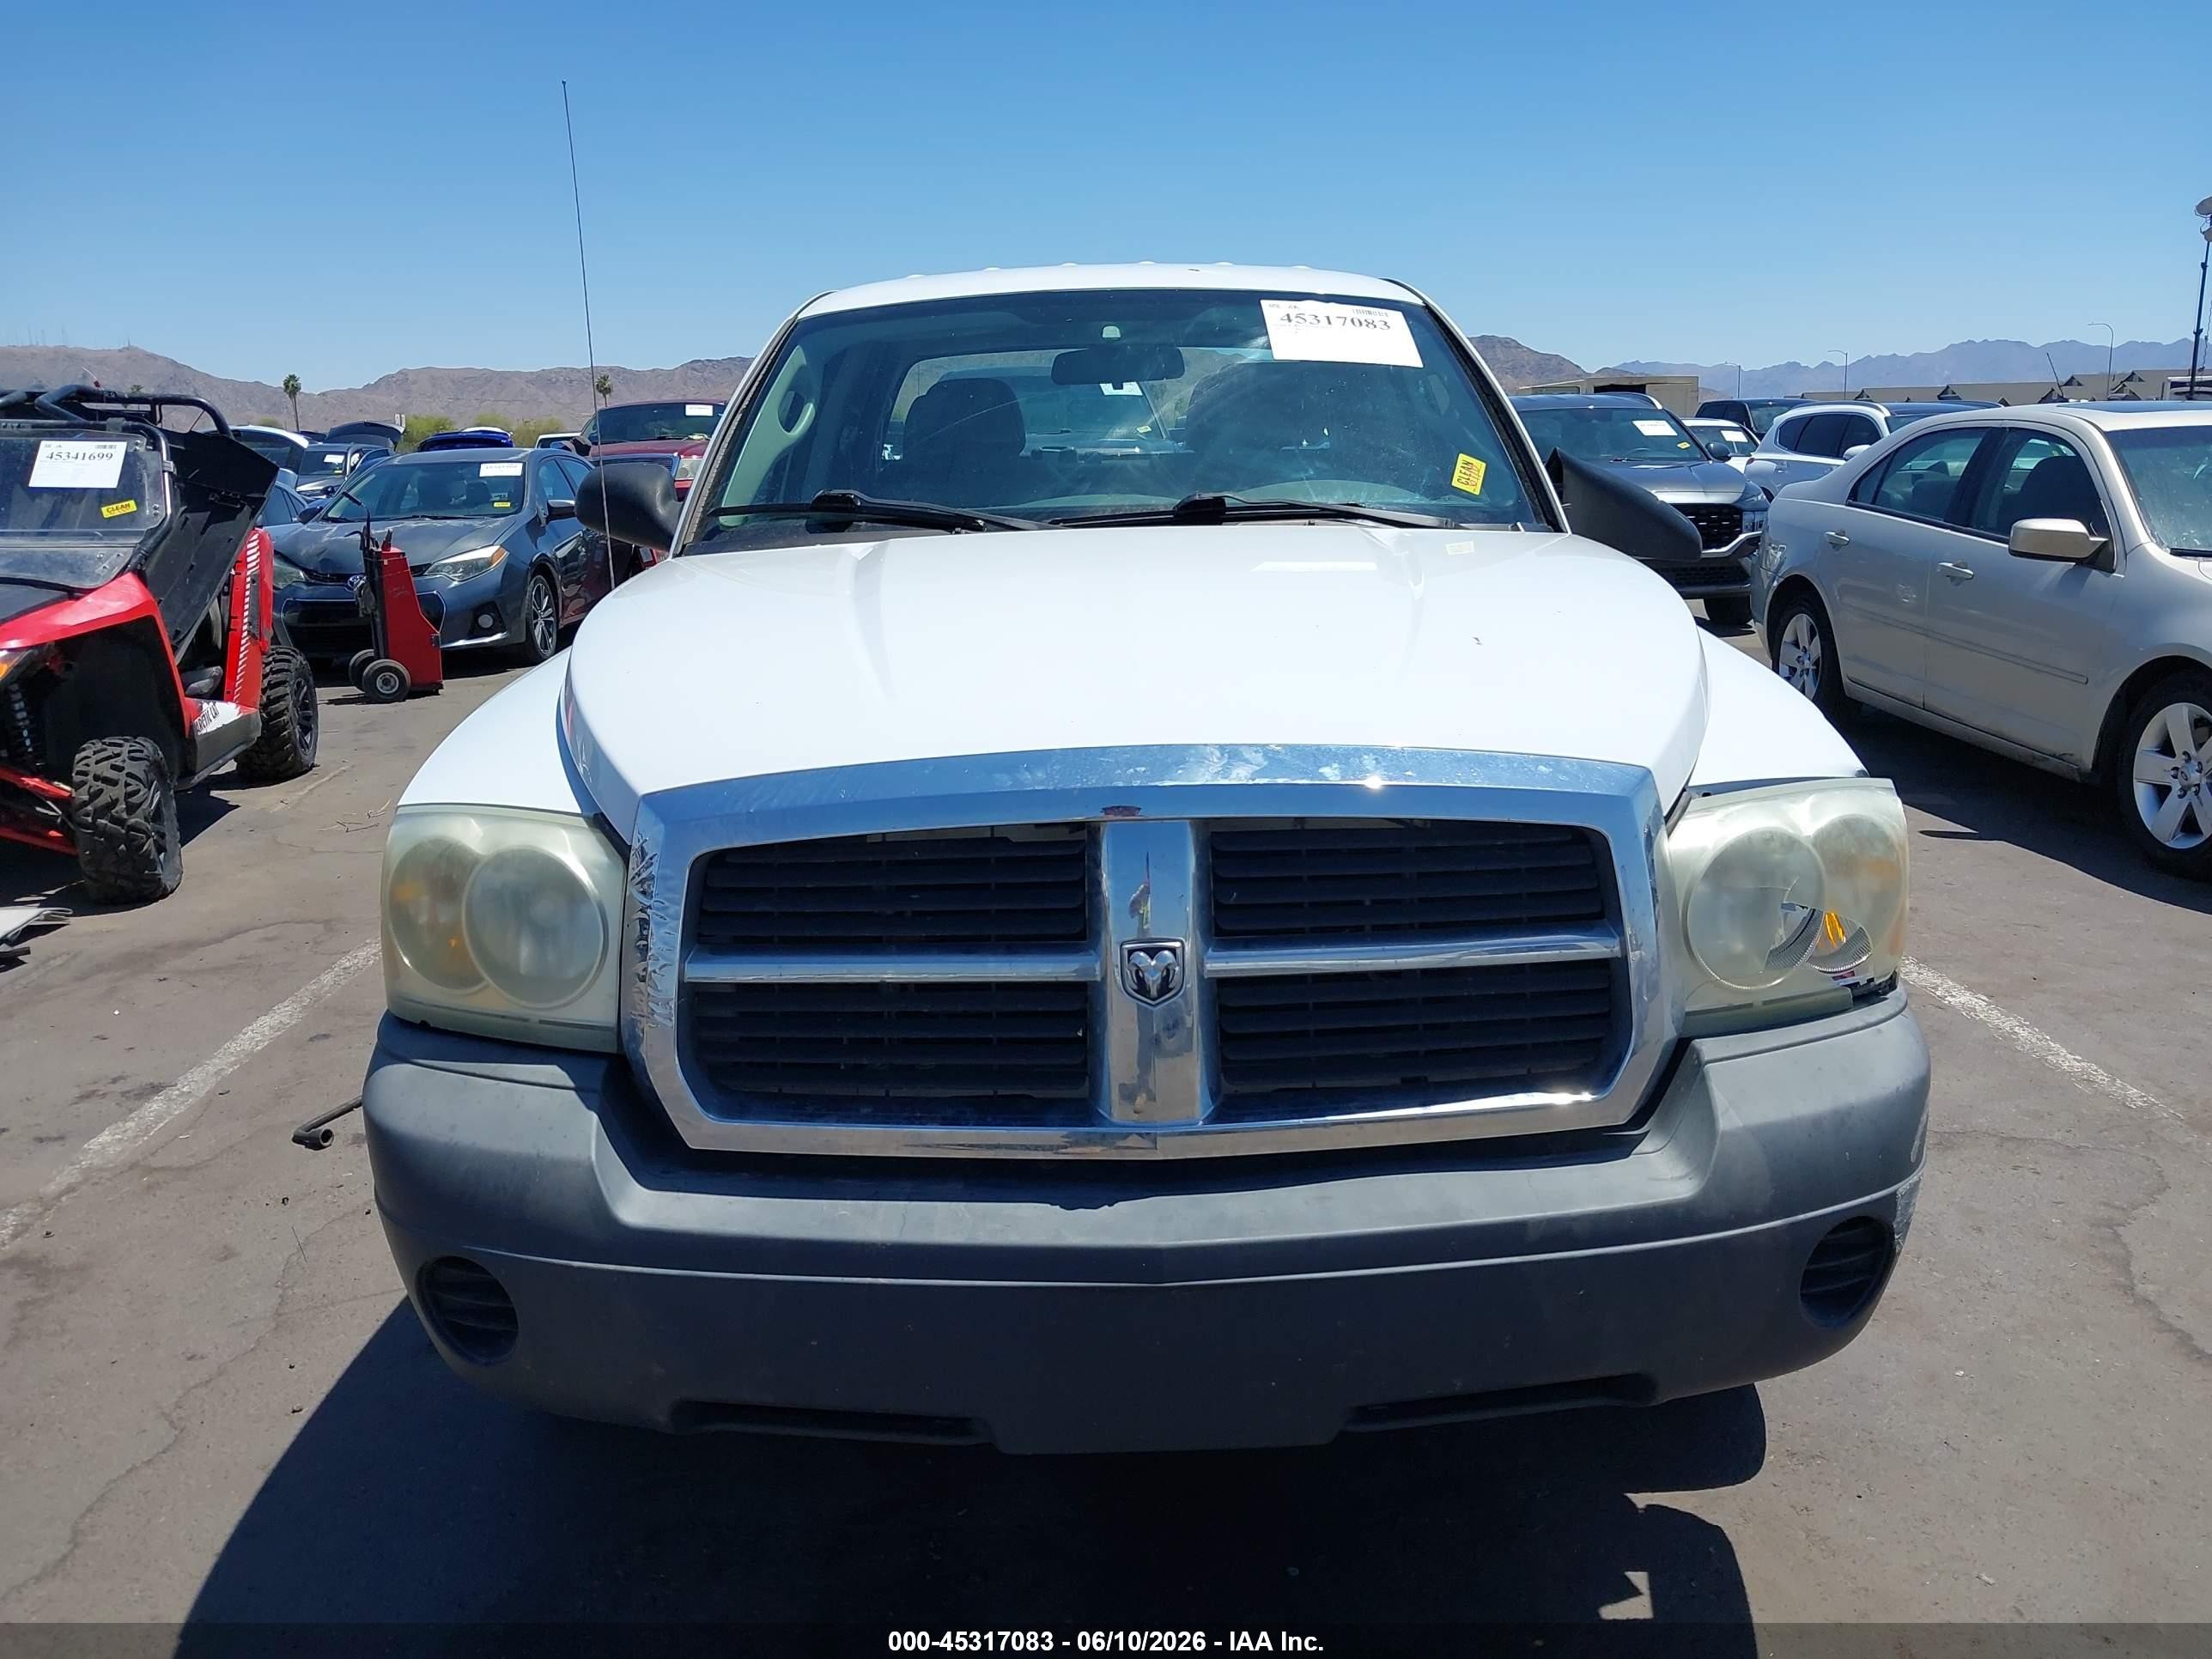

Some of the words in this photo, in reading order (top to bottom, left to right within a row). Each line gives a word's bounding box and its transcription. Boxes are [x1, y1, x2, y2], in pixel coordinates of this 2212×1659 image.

[1279, 313, 1391, 331] 45317083
[46, 452, 113, 461] 45341699
[1456, 459, 1474, 486] CLEAN
[106, 502, 131, 514] CLEAN
